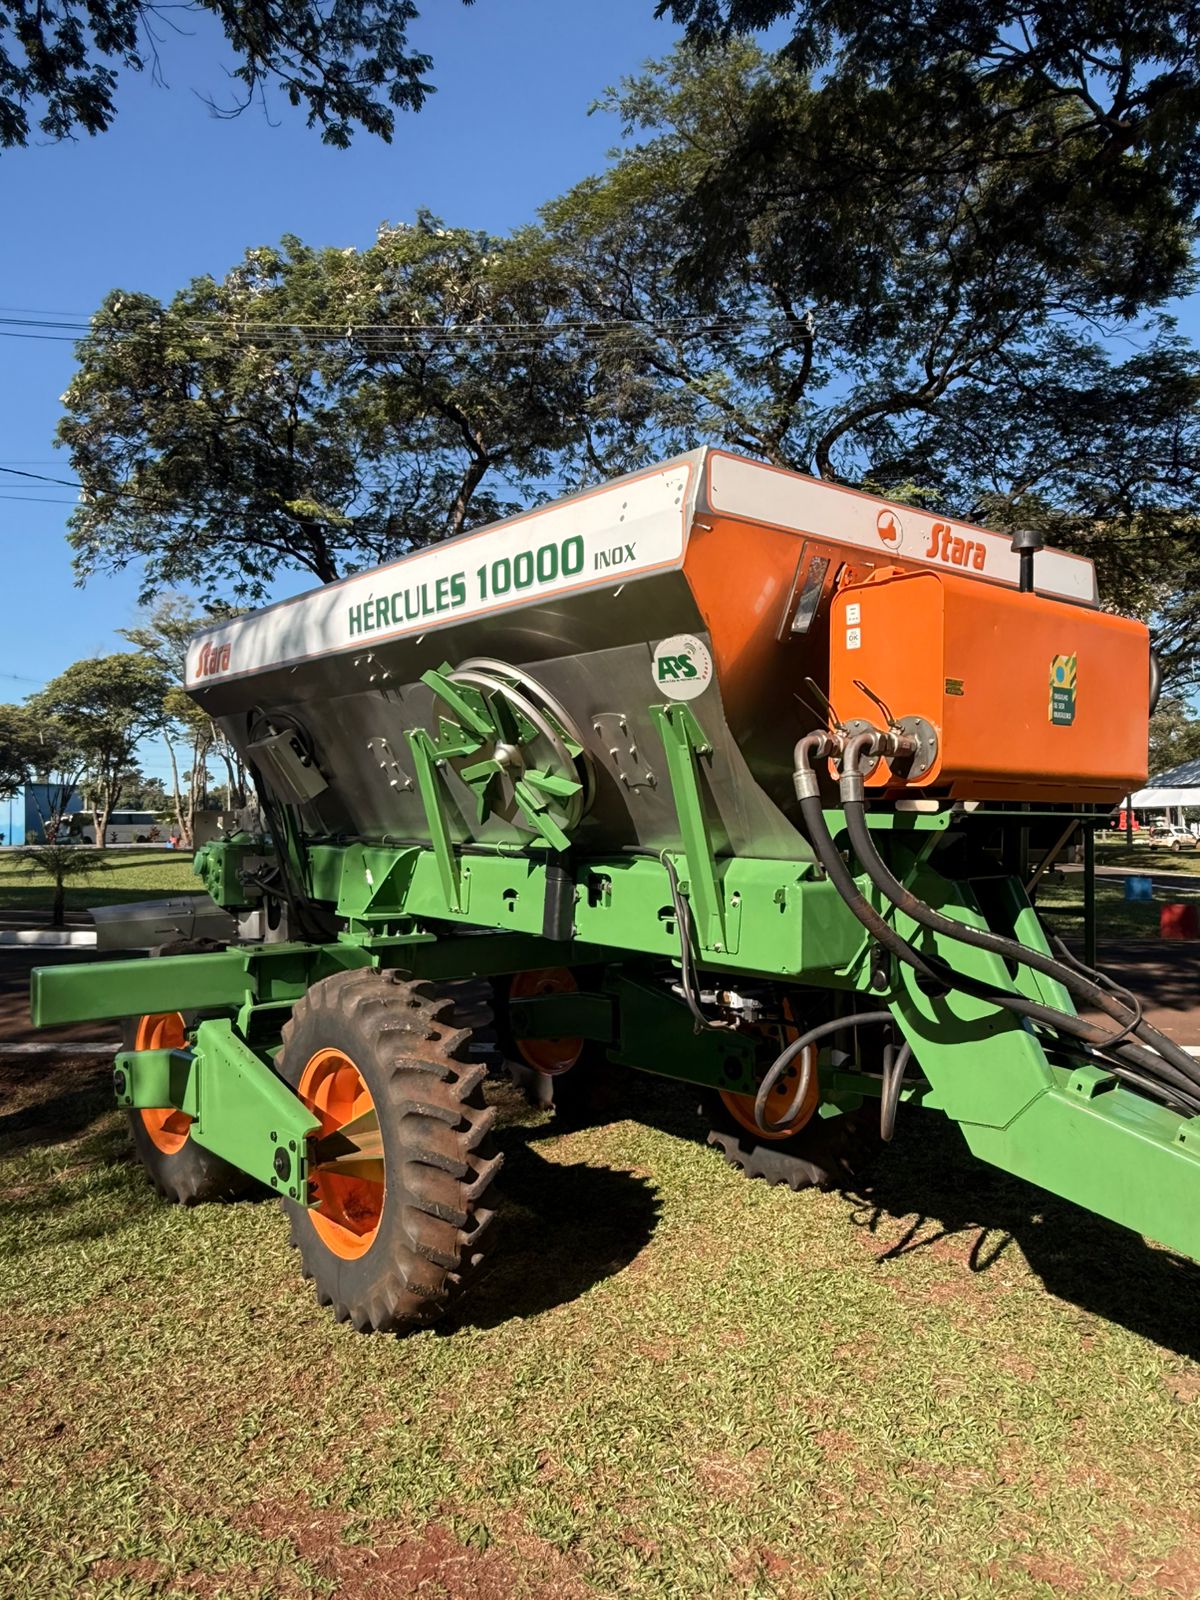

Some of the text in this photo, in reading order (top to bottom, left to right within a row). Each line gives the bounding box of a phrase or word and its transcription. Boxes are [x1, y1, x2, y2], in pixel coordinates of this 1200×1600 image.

[926, 522, 986, 571] Stara
[348, 534, 637, 637] HÉRCULES 10000 INOX
[195, 641, 232, 678] Stara
